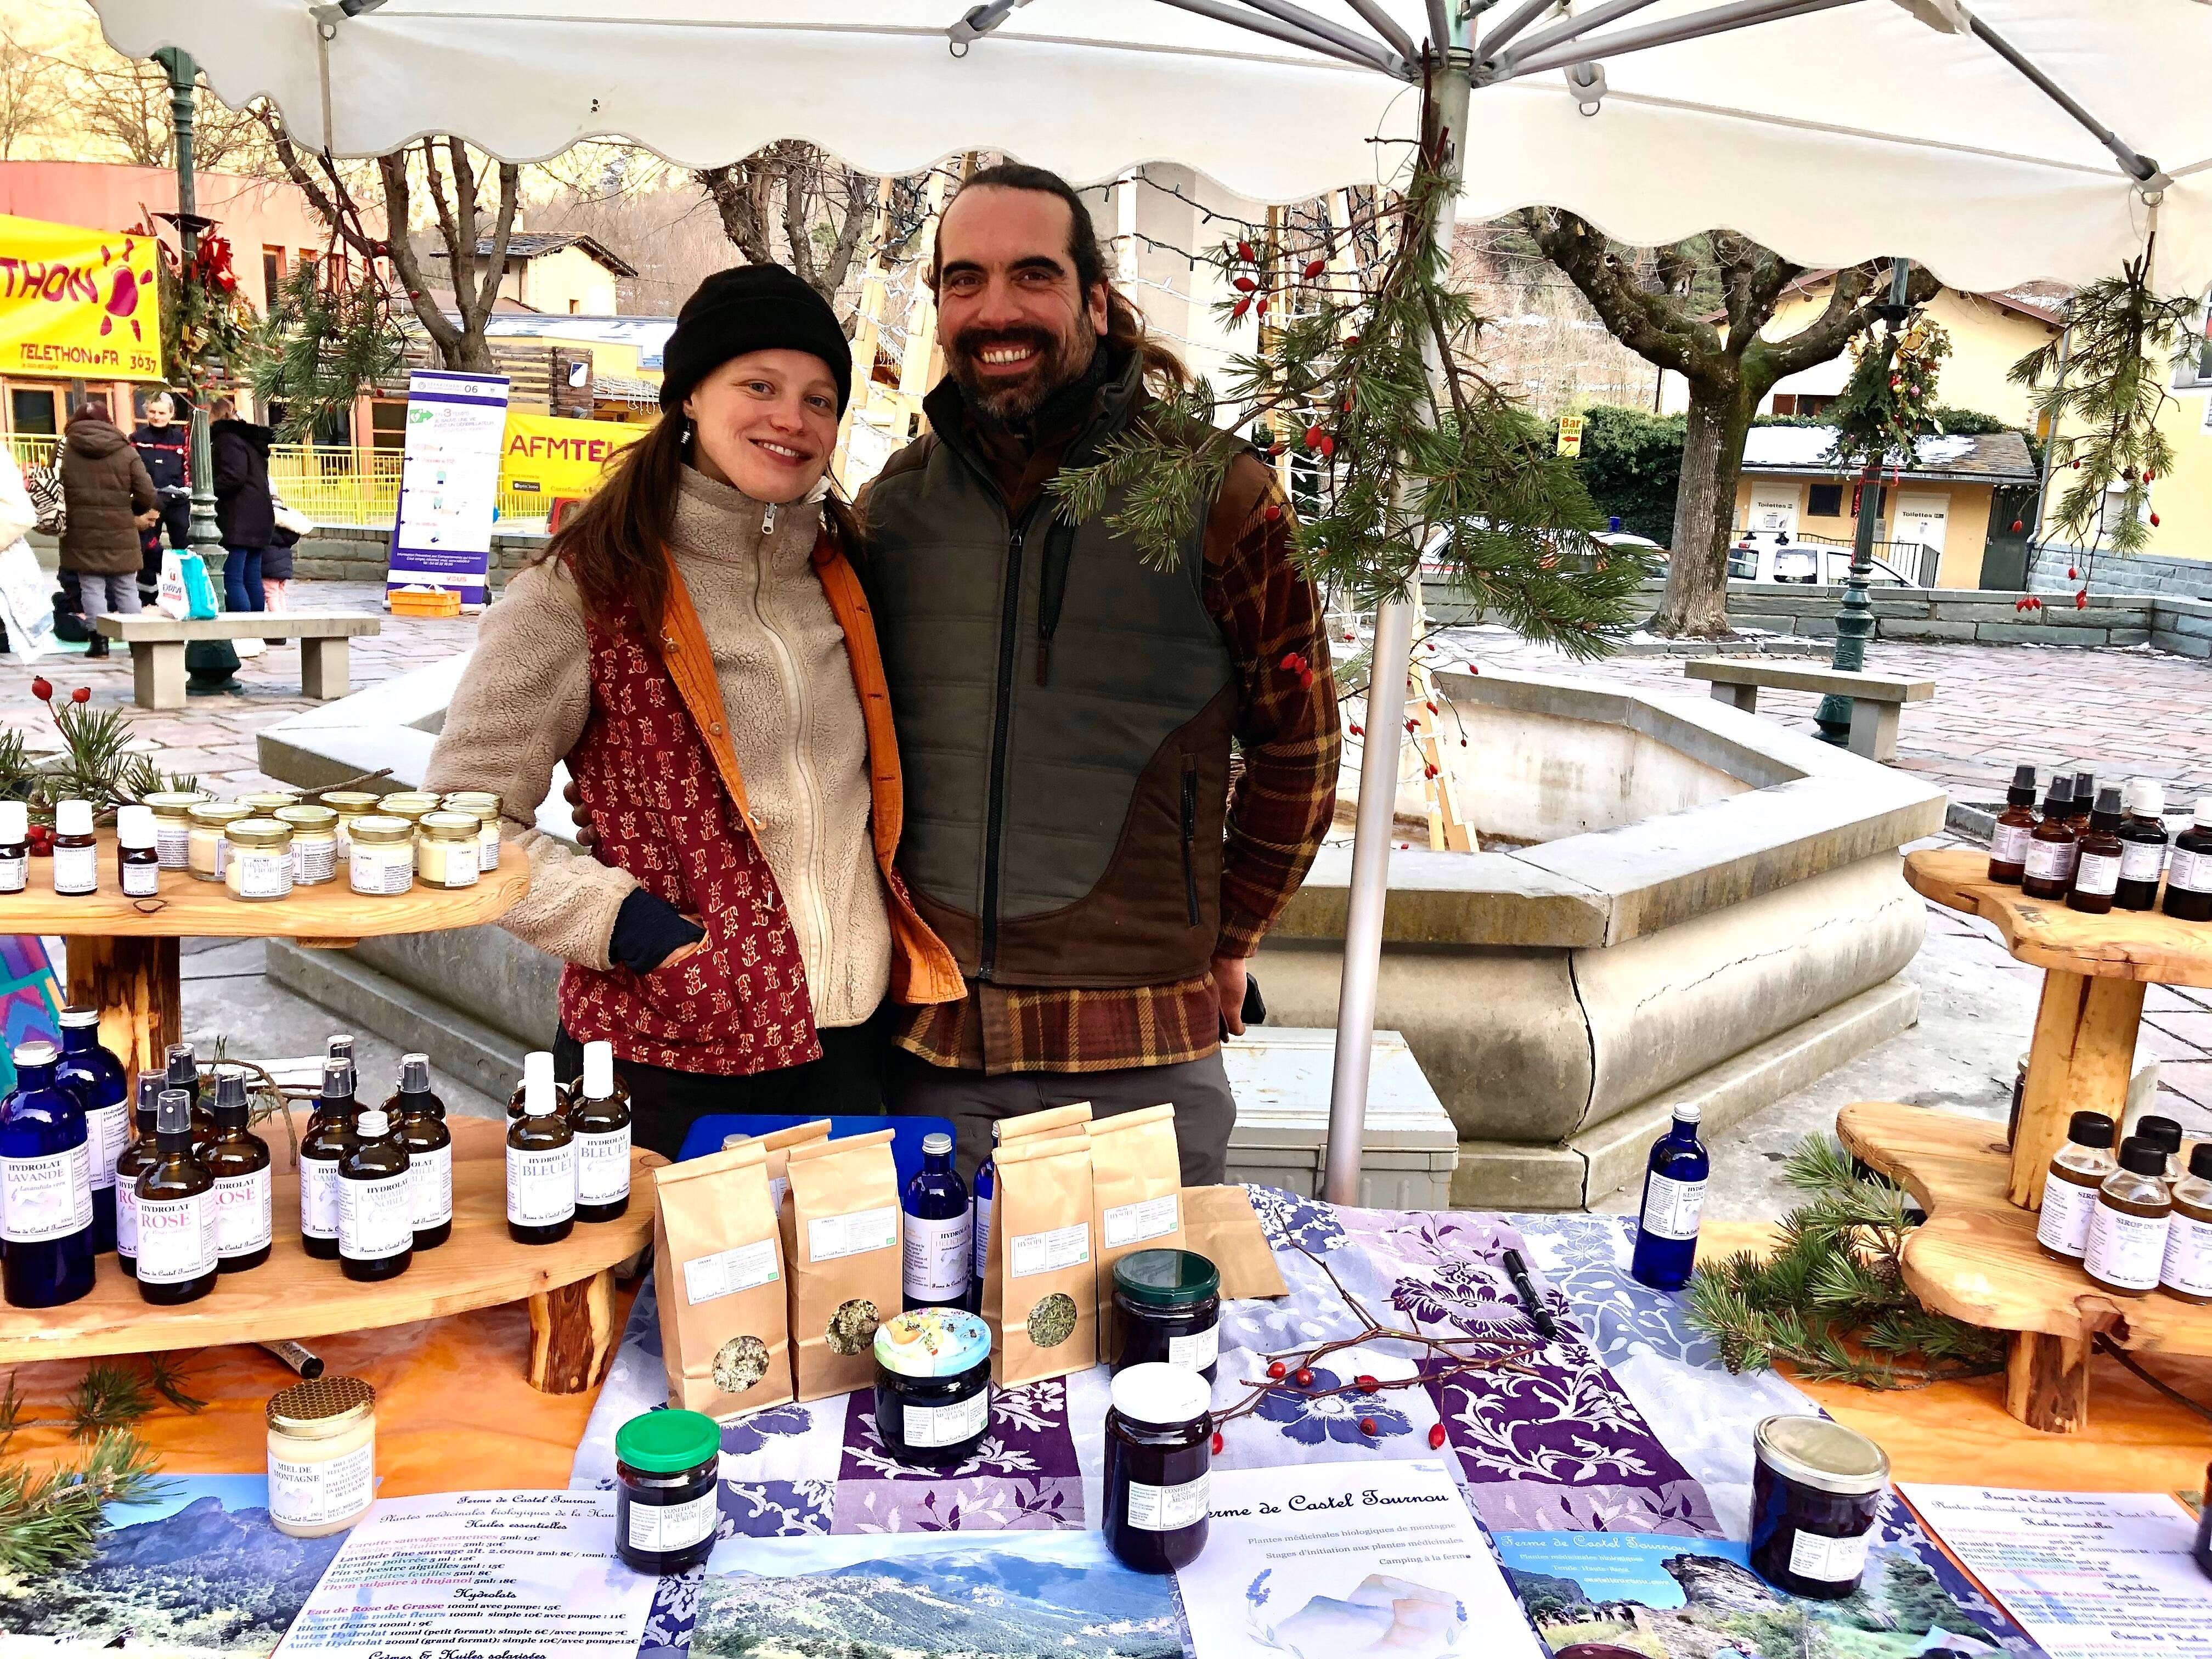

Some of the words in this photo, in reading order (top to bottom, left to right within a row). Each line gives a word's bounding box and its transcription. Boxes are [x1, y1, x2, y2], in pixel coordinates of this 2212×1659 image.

[464, 385, 478, 393] 06
[444, 408, 452, 417] 3
[1562, 417, 1581, 428] Bar
[588, 1135, 627, 1146] HYDROLAT
[581, 1140, 629, 1158] BLEUET
[529, 1152, 569, 1164] HYDROLAT
[9, 1160, 62, 1172] HYDROLAT
[523, 1159, 573, 1177] BLEUET
[8, 1168, 64, 1182] LAVANDE
[215, 1178, 256, 1190] YDROLAT
[366, 1177, 409, 1194] HYDROLAT
[216, 1186, 256, 1205] OSE
[141, 1203, 191, 1213] HYDROLAT
[141, 1212, 192, 1229] ROSE
[2115, 1216, 2143, 1229] SIROP
[278, 1462, 297, 1474] MIEL
[274, 1469, 320, 1482] MONTAGNE
[1165, 1483, 1196, 1494] CONFITURE
[457, 1496, 492, 1504] Ferme
[512, 1494, 549, 1503] Castel
[550, 1495, 597, 1504] Tournou
[1208, 1506, 1252, 1519] erme
[1259, 1502, 1282, 1515] de
[1288, 1493, 1355, 1512] Castel
[1362, 1489, 1449, 1506] Tournou
[379, 1515, 421, 1523] Plantes
[425, 1509, 485, 1519] médicinales
[491, 1508, 550, 1518] biologiques
[571, 1509, 581, 1517] la
[464, 1520, 505, 1528] Huiles
[509, 1521, 568, 1530] essentielles
[1248, 1536, 1283, 1545] Plantes
[1284, 1531, 1340, 1543] médicinales
[1341, 1526, 1395, 1538] biologiques
[1410, 1522, 1457, 1532] montagne
[1266, 1551, 1297, 1561] Stages
[1299, 1545, 1351, 1557] d'initiation
[1372, 1540, 1407, 1551] plantes
[1408, 1537, 1464, 1548] médicinales
[1500, 1535, 1548, 1548] Ferme
[1552, 1537, 1570, 1547] de
[1573, 1534, 1621, 1549] Castel
[1626, 1536, 1688, 1552] Tournou
[334, 1561, 381, 1570] Menthe
[382, 1556, 427, 1566] poivrée
[338, 1553, 390, 1563] Lavande
[1379, 1555, 1424, 1566] Camping
[1431, 1553, 1442, 1562] la
[353, 1565, 407, 1576] sylvestre
[408, 1562, 460, 1571] aiguilles
[363, 1572, 406, 1582] petites
[408, 1570, 452, 1578] feuilles
[322, 1583, 357, 1592] Thym
[359, 1579, 408, 1588] vulgaire
[420, 1577, 472, 1585] thujanol
[453, 1588, 517, 1601] Hydrolats
[351, 1605, 382, 1613] Rose
[402, 1602, 444, 1611] Grasse
[296, 1623, 337, 1632] Bleuet
[339, 1622, 377, 1630] fleurs
[330, 1629, 387, 1640] Hydrolat
